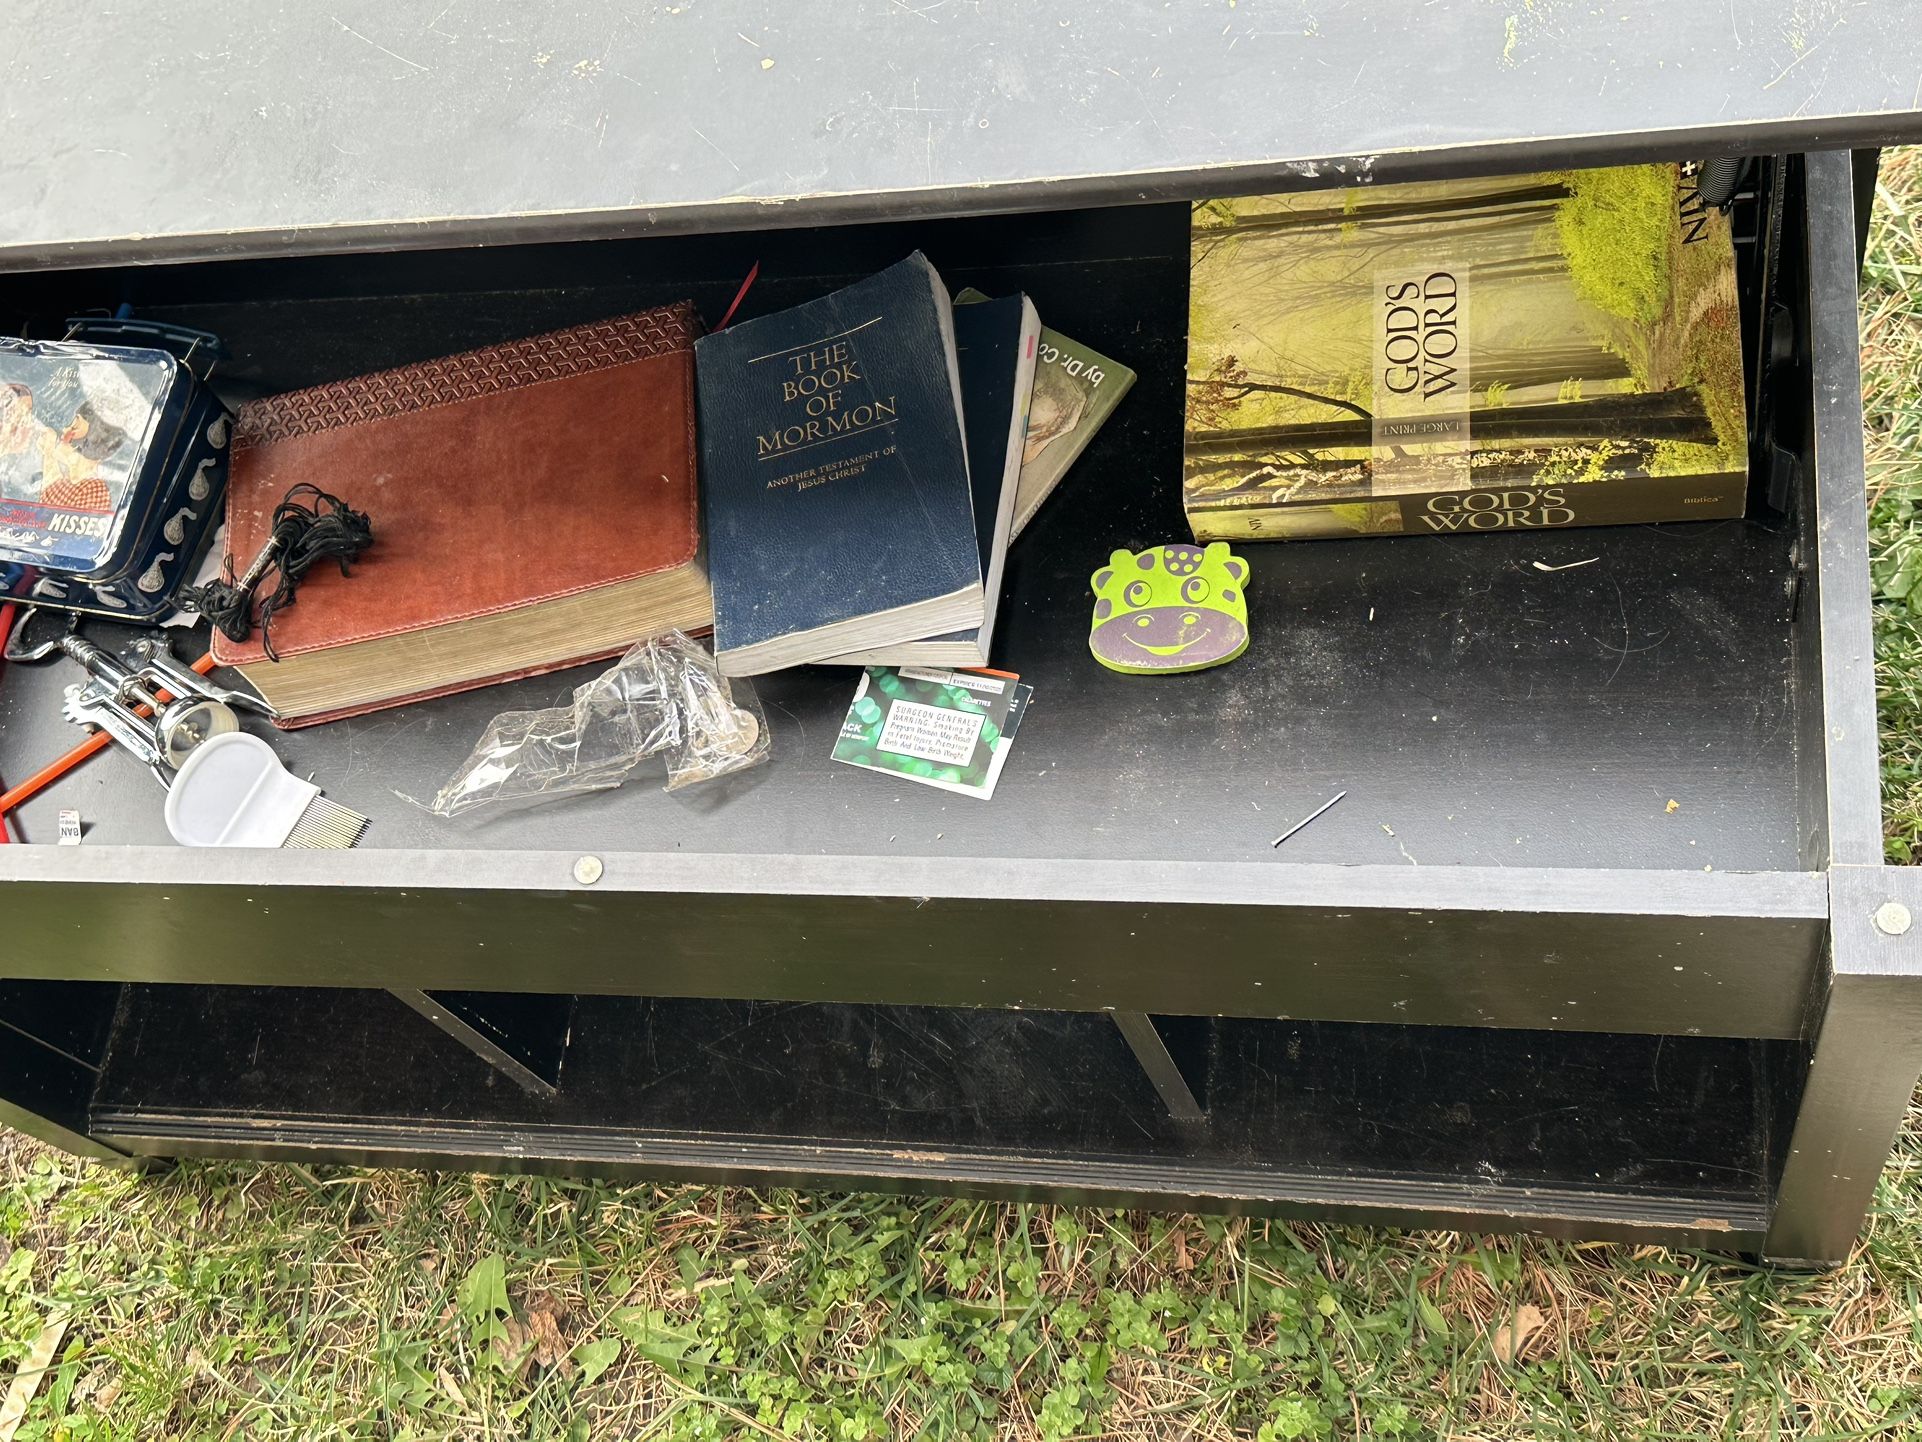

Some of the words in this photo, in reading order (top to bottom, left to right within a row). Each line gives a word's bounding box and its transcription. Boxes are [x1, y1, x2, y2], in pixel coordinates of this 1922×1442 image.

[1678, 183, 1709, 245] NIV
[1384, 281, 1420, 394] GOD'S
[1422, 272, 1458, 402] WORD
[787, 341, 849, 376] THE
[1060, 354, 1085, 377] Dr.
[782, 361, 861, 402] BOOK
[1082, 365, 1106, 388] by
[805, 389, 842, 416] OF
[756, 396, 896, 455] MORMON
[1382, 423, 1417, 436] PRINT
[1419, 421, 1460, 433] LARGE
[766, 468, 817, 489] ANOTHER
[819, 451, 880, 474] TESTAMENT
[883, 445, 898, 456] OF
[797, 475, 827, 492] JESUS
[828, 464, 867, 481] CHRIST
[1426, 488, 1567, 514] GOD'S
[47, 513, 107, 538] KISSES
[1418, 506, 1576, 532] WORD
[896, 706, 934, 719] SURGEON
[895, 731, 913, 740] Fetal
[916, 726, 938, 737] Women
[940, 731, 953, 741] May
[953, 733, 972, 744] Result
[933, 721, 964, 734] Smoking
[900, 740, 913, 750] And
[914, 743, 926, 753] Low
